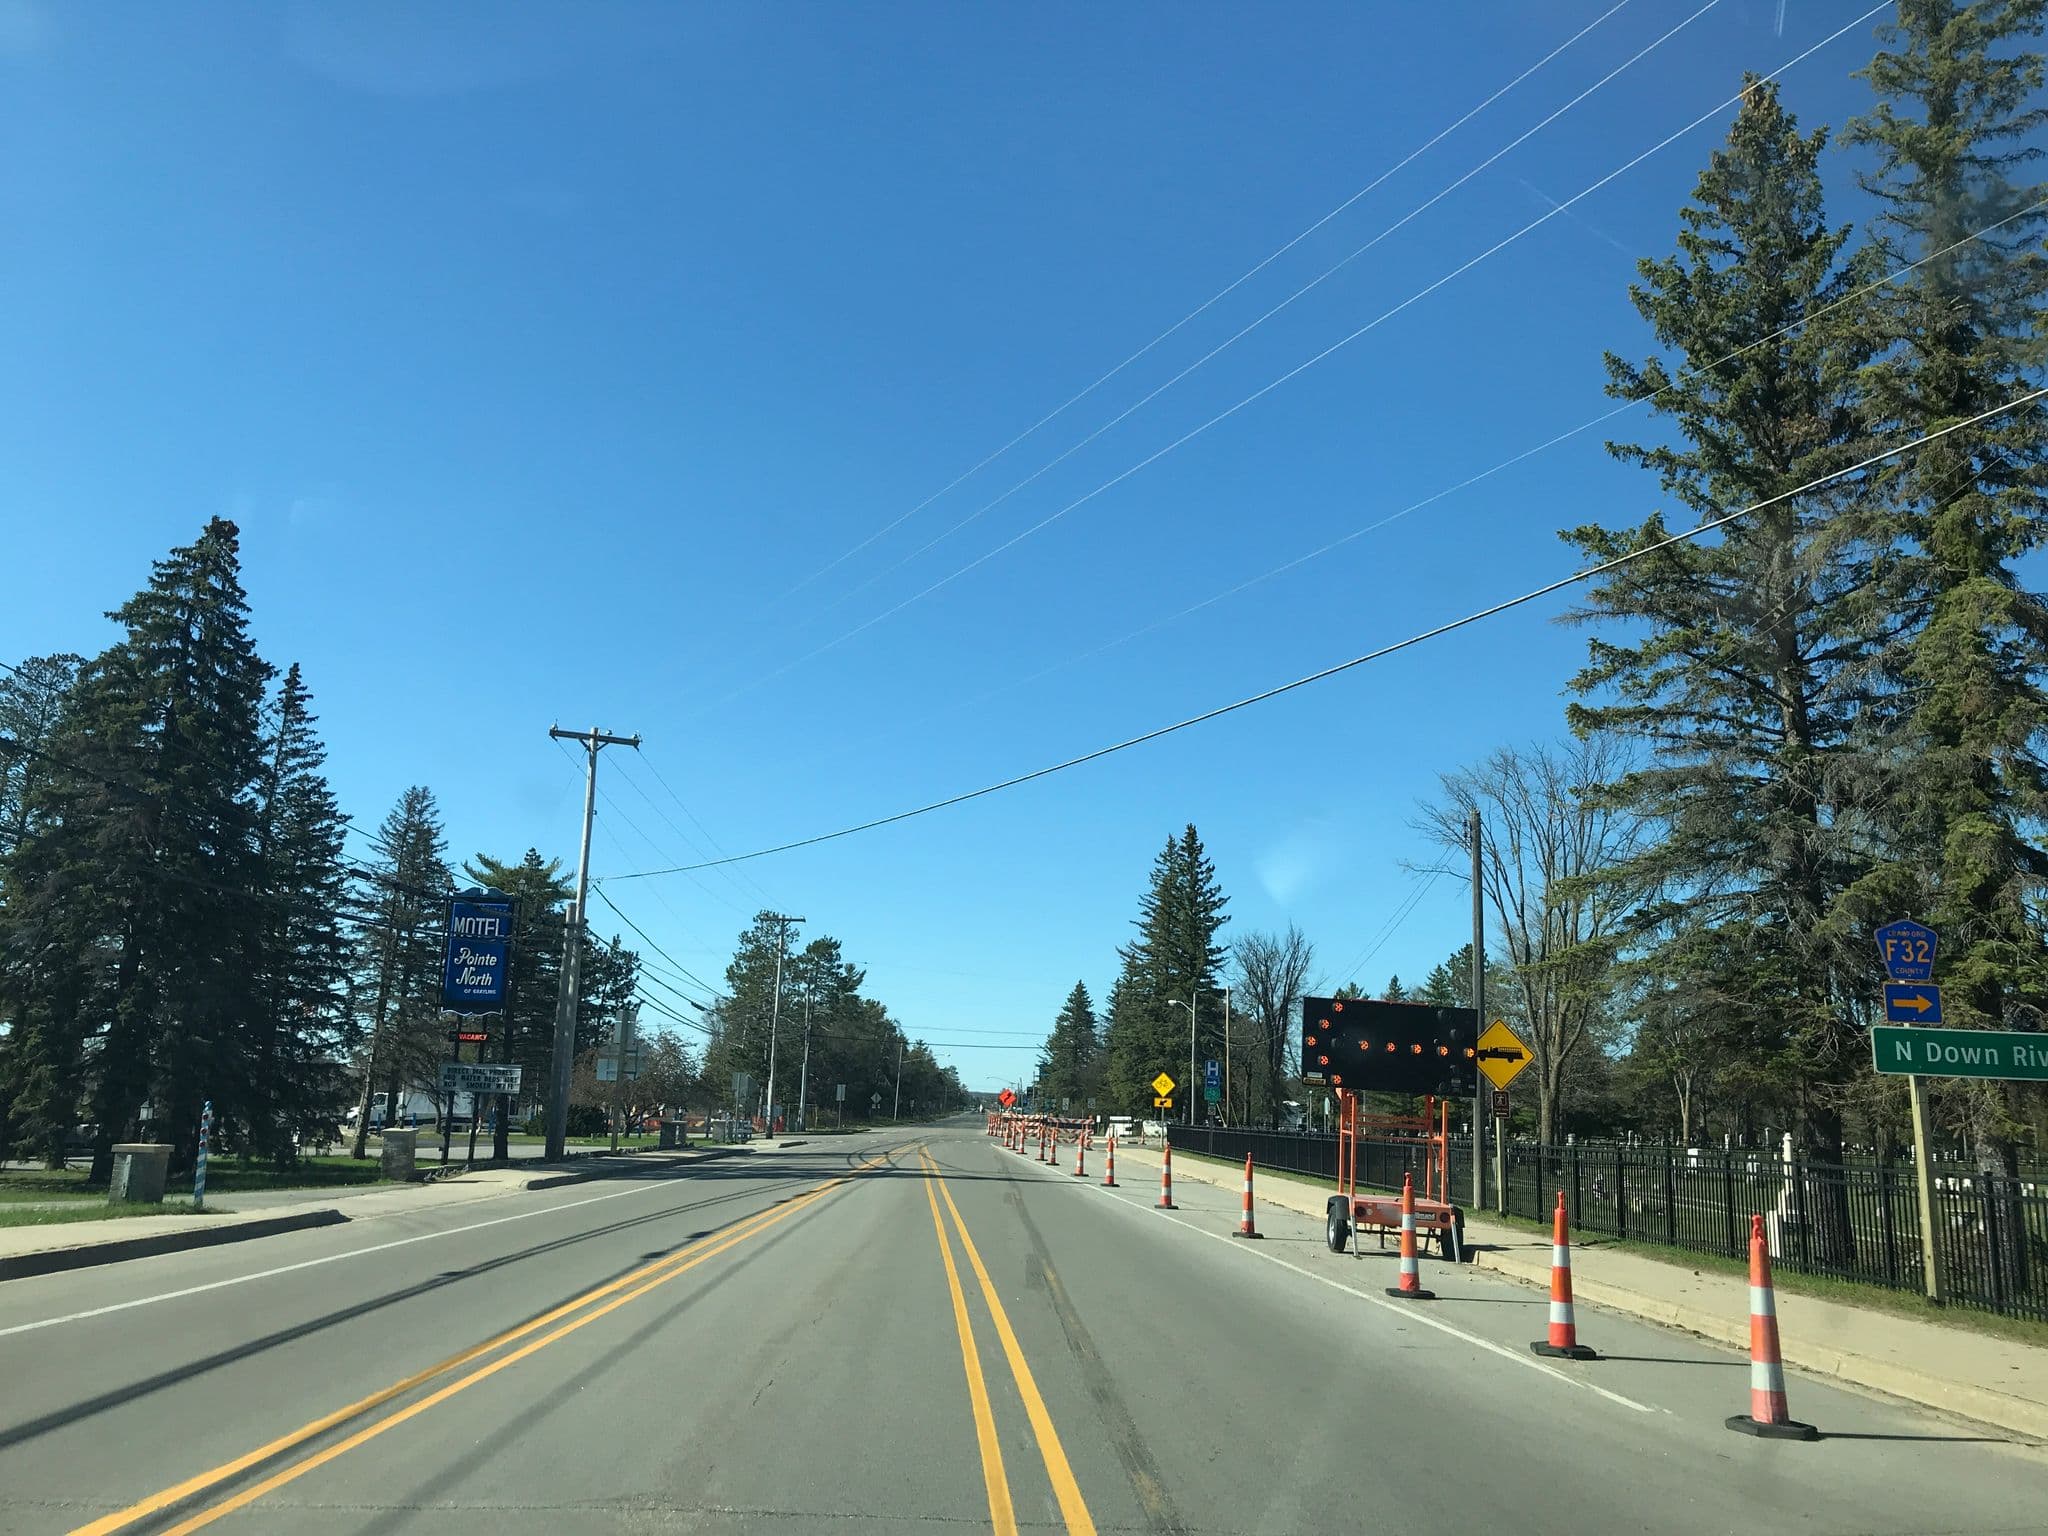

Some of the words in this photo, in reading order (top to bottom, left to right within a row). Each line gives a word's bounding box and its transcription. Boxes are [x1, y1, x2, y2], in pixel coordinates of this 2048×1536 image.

[454, 917, 504, 937] MOTEL
[454, 947, 497, 966] Pointe
[1885, 938, 1930, 963] F32
[456, 966, 493, 986] North
[1895, 967, 1924, 975] COUNTY
[458, 1033, 487, 1041] VACANCY
[1895, 1040, 1912, 1061] N
[1926, 1042, 1999, 1066] Down
[1207, 1061, 1219, 1076] H
